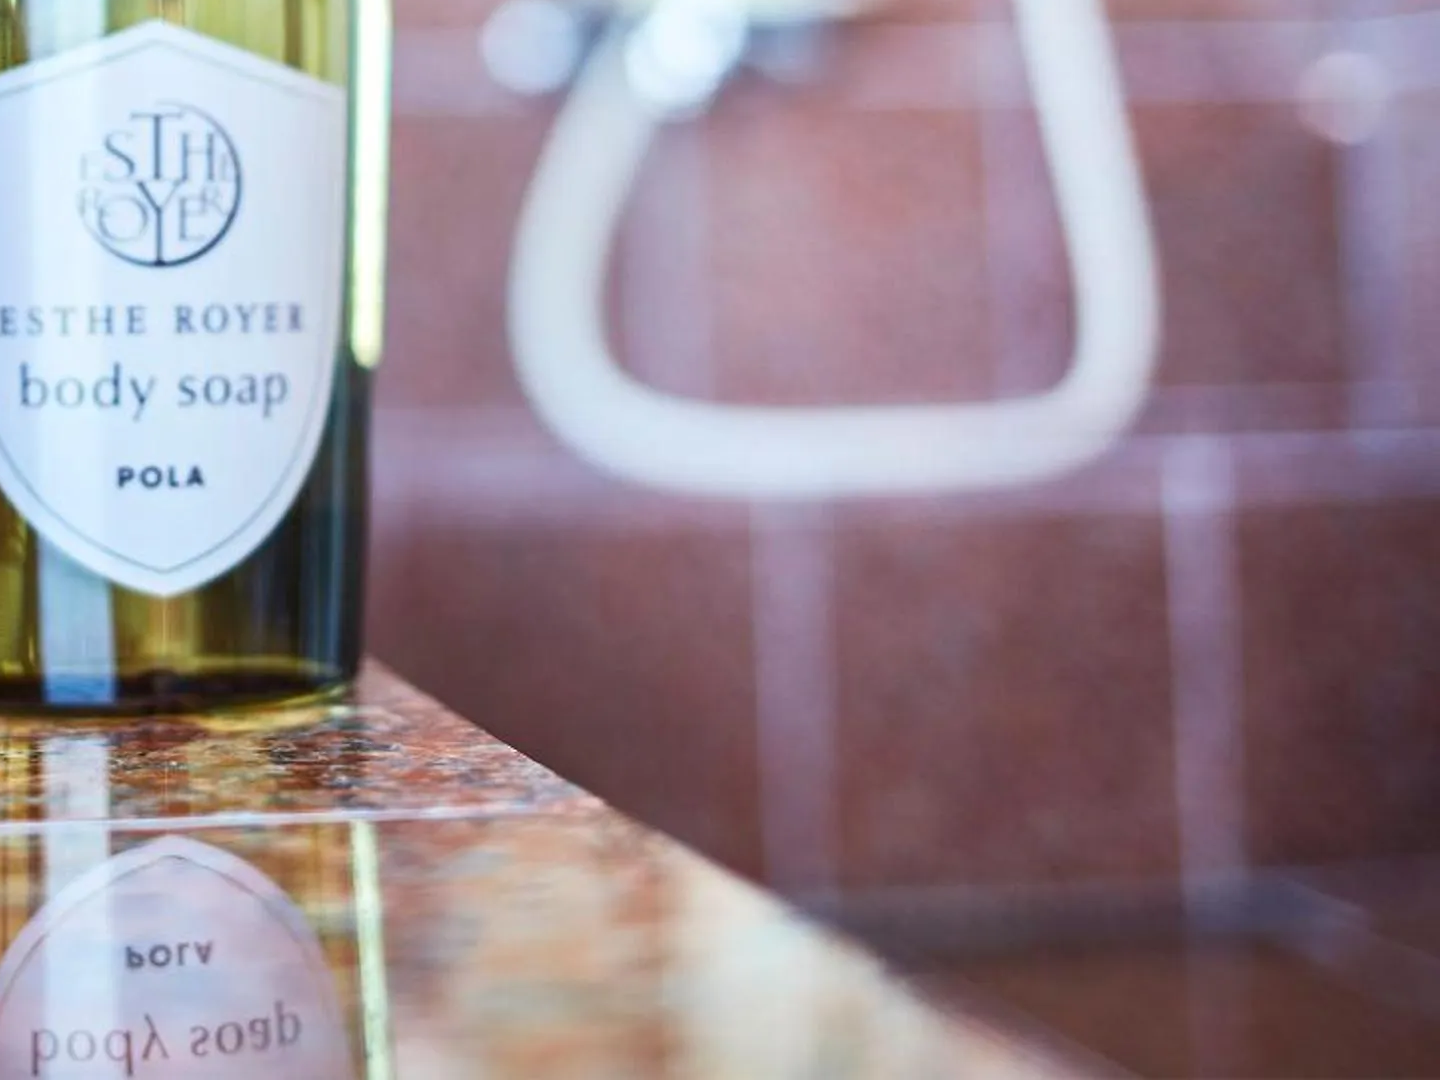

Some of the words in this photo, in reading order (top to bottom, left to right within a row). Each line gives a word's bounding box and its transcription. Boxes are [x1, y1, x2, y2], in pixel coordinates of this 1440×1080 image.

[173, 301, 306, 335] ROYER
[19, 362, 157, 422] body
[176, 372, 289, 420] soap
[116, 465, 206, 490] POLA
